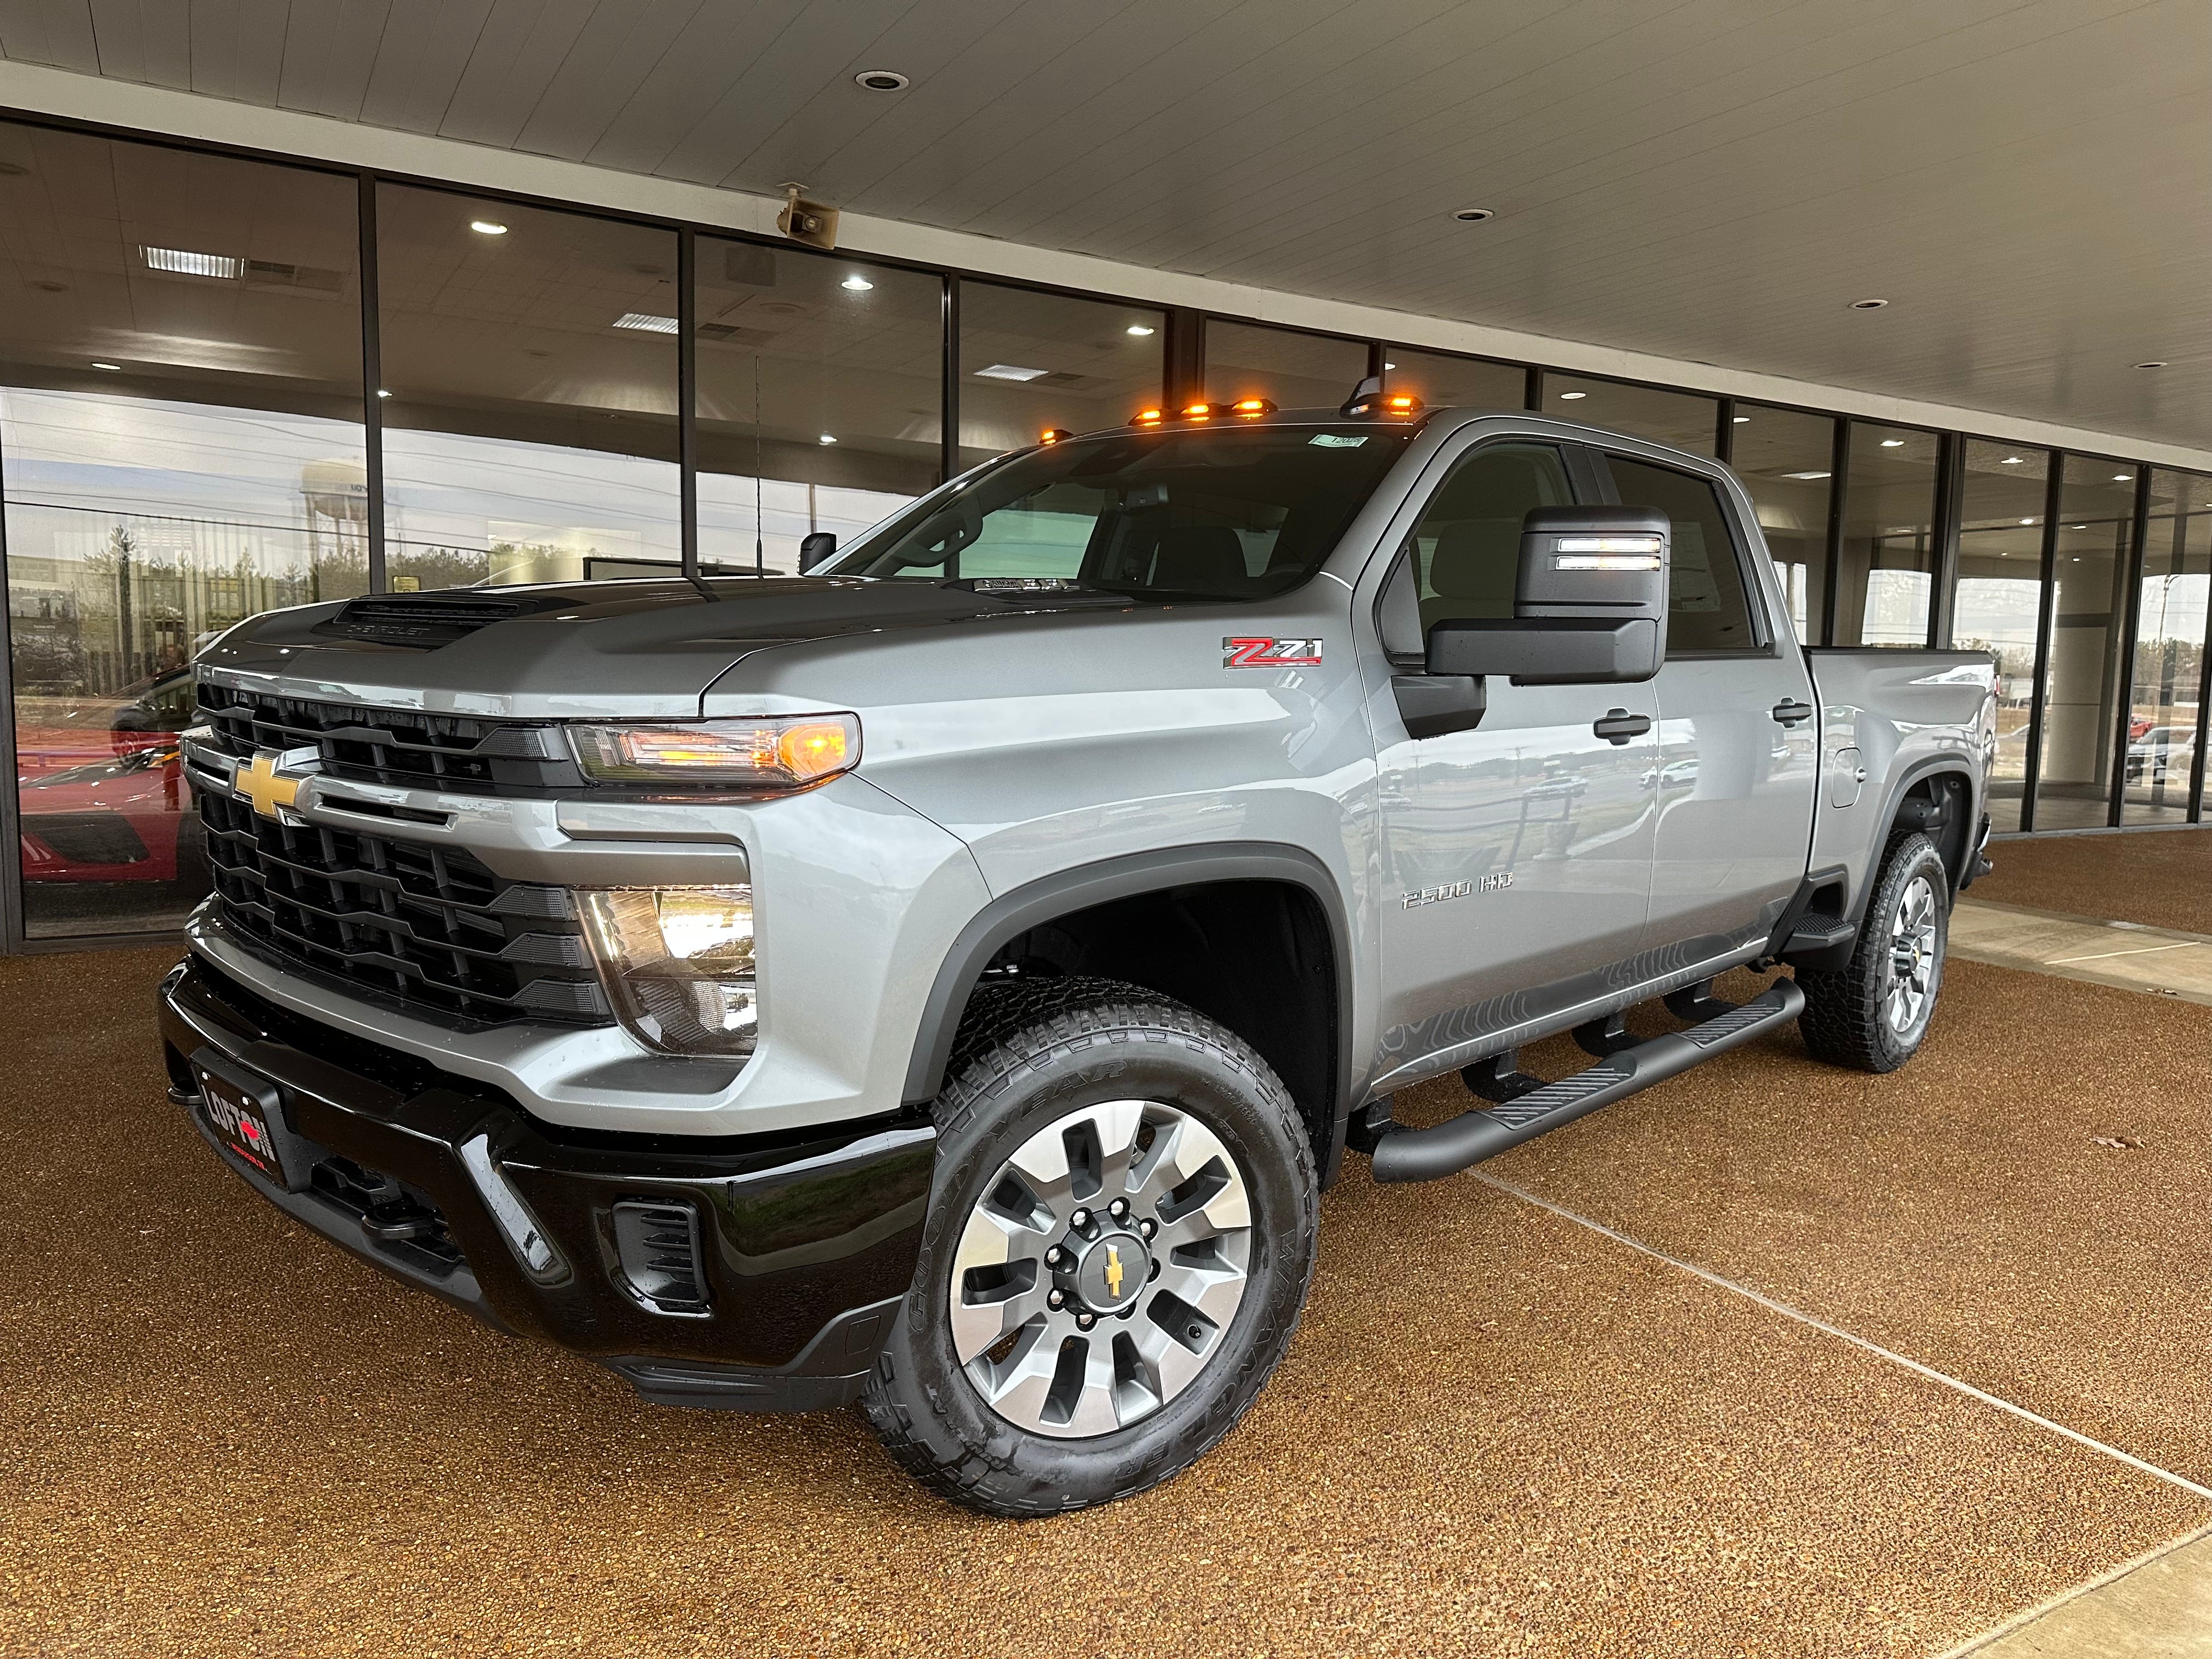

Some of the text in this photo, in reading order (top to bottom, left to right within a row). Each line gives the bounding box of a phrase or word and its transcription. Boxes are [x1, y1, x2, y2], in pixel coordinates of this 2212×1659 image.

[347, 624, 431, 636] CHEVROLET
[1223, 637, 1323, 669] Z71
[1402, 871, 1514, 910] 2500 HD
[201, 1084, 275, 1162] LOFTON
[909, 1062, 1126, 1331] GOODYEAR
[1115, 1229, 1296, 1481] WRANGLER
